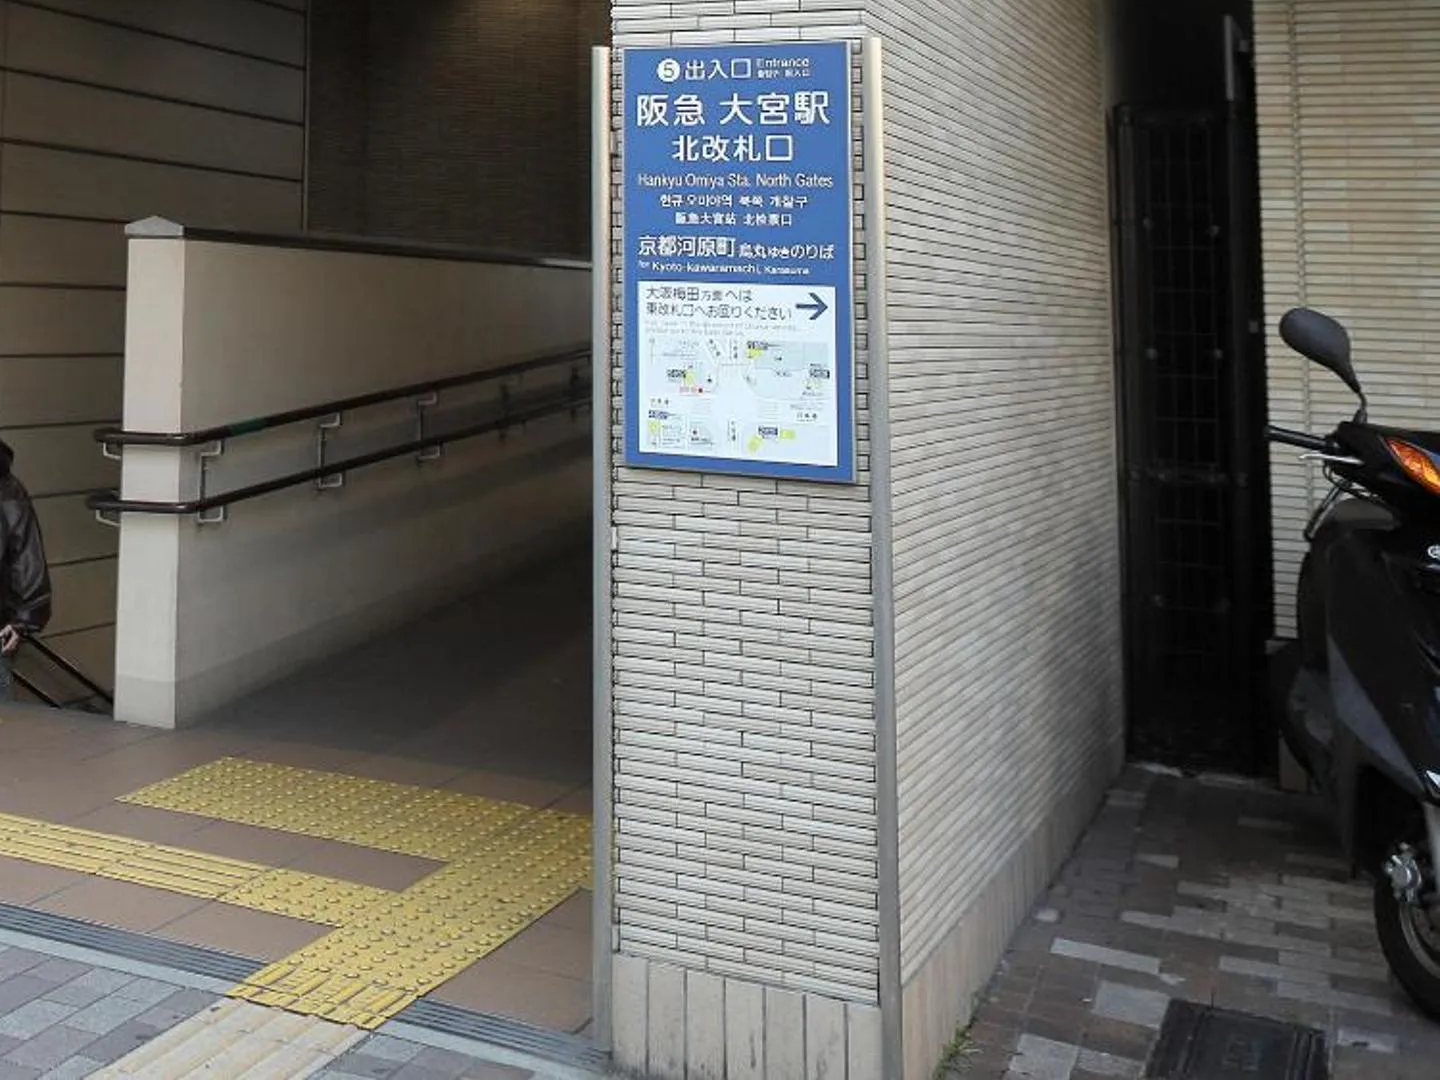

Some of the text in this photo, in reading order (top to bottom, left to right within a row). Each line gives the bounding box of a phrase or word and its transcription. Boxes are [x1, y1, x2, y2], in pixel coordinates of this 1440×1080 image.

[685, 58, 752, 81] 出入口
[756, 58, 810, 68] Entrance
[636, 90, 830, 127] 阪急 大宮駅
[671, 134, 794, 162] 北改札口
[638, 173, 834, 190] Hankyu Omiya Sta. North Gates
[638, 235, 736, 257] 京都河原町
